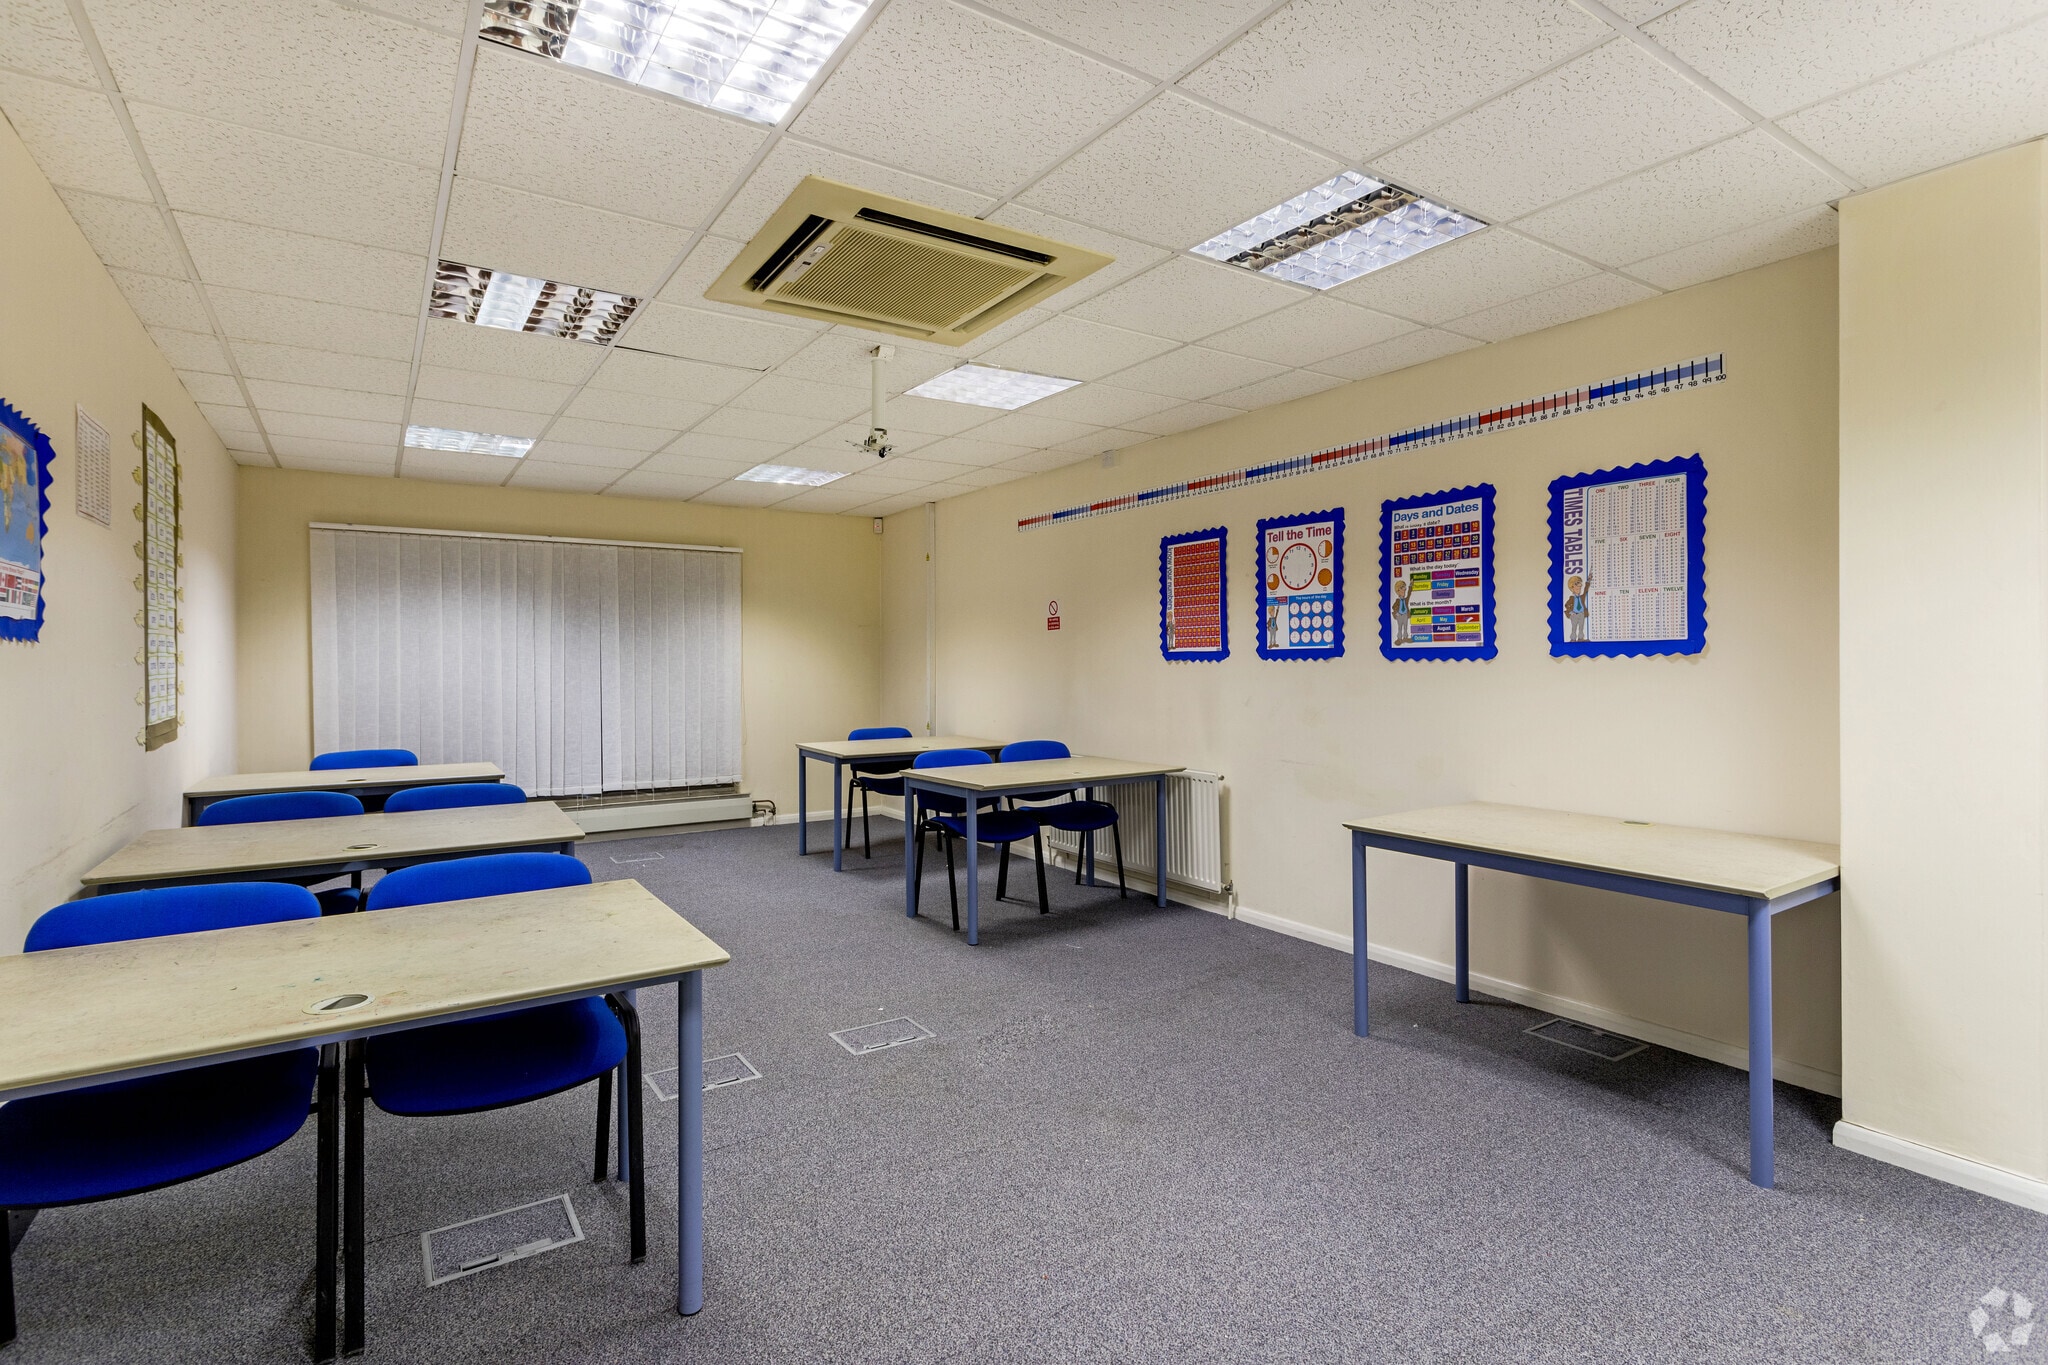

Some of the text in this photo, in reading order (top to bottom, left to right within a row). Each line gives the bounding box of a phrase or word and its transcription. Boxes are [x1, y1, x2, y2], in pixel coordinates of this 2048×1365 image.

[1394, 503, 1479, 522] Days and Dates
[1267, 526, 1331, 543] Tell the Time
[1565, 489, 1583, 574] TIMES TABLES
